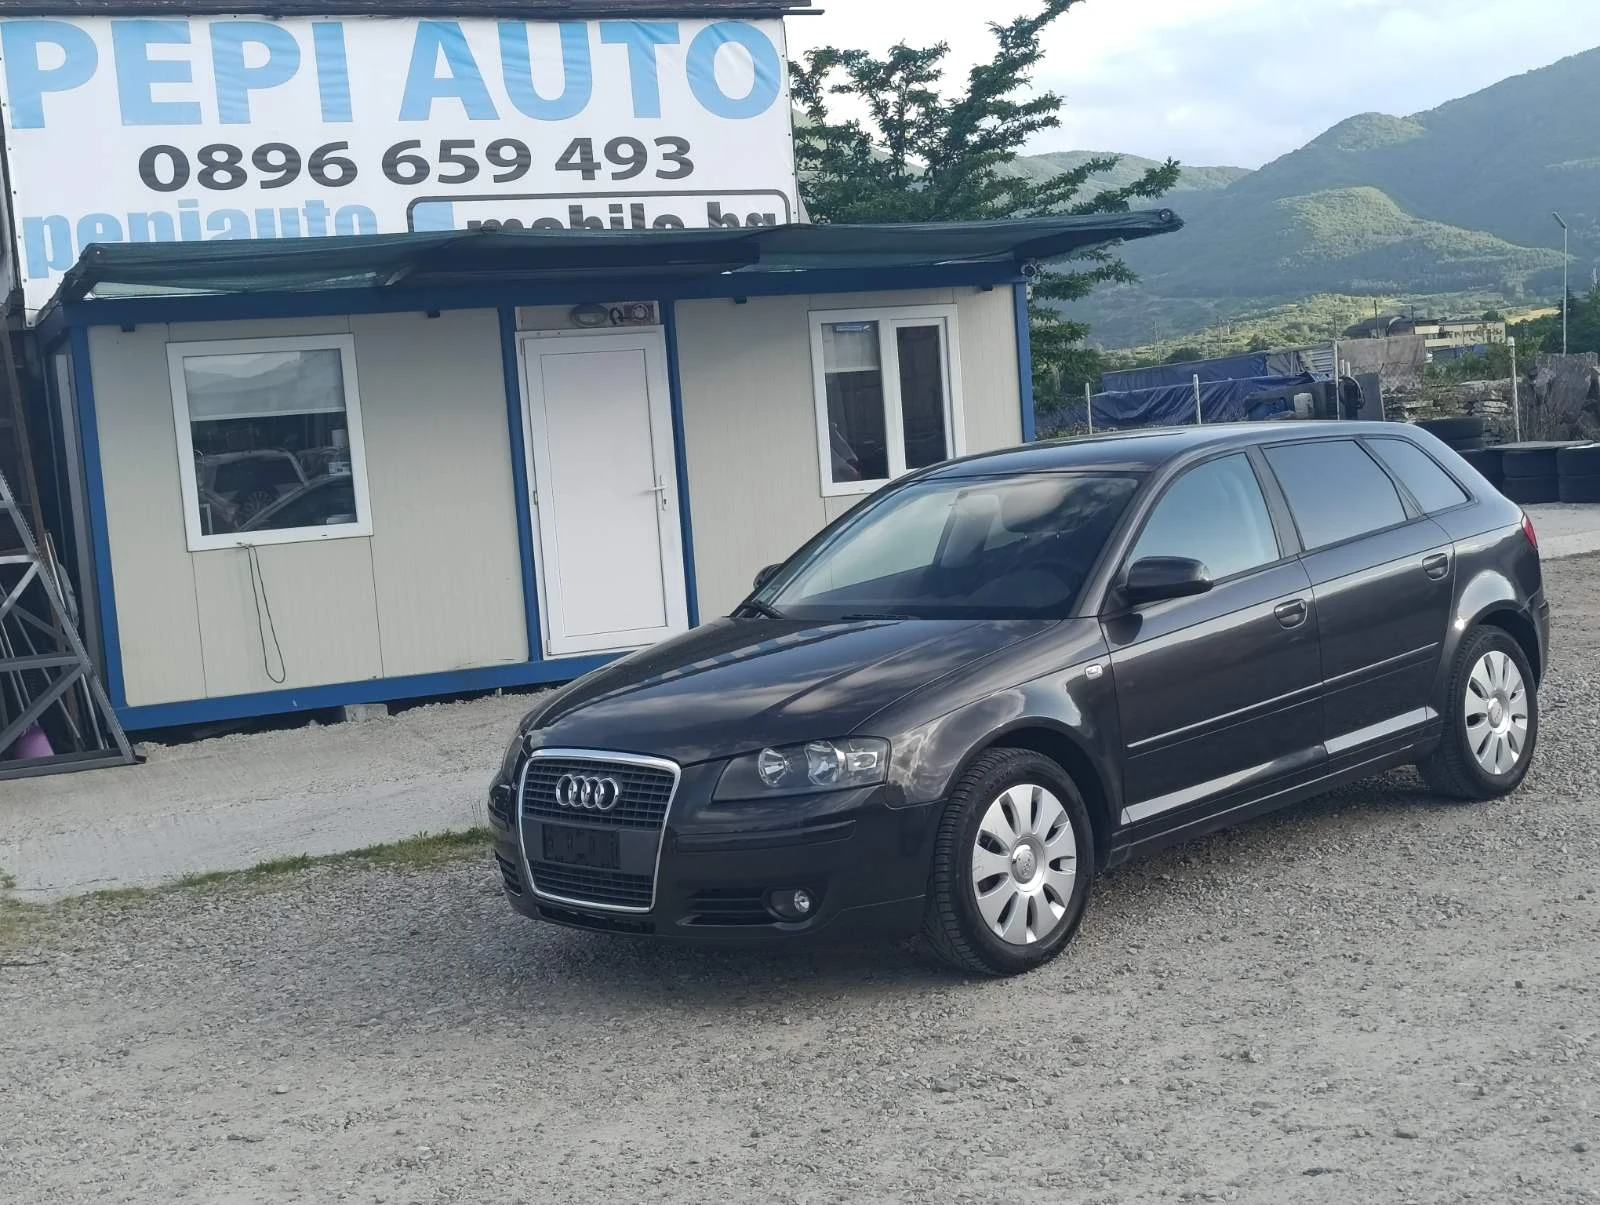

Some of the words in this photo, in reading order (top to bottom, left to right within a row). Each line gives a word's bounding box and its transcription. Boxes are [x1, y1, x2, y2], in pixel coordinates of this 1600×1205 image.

[0, 20, 354, 129] PEPI
[398, 19, 782, 122] AUTO
[138, 141, 358, 192] 0896
[381, 138, 532, 186] 659
[554, 136, 695, 181] 493
